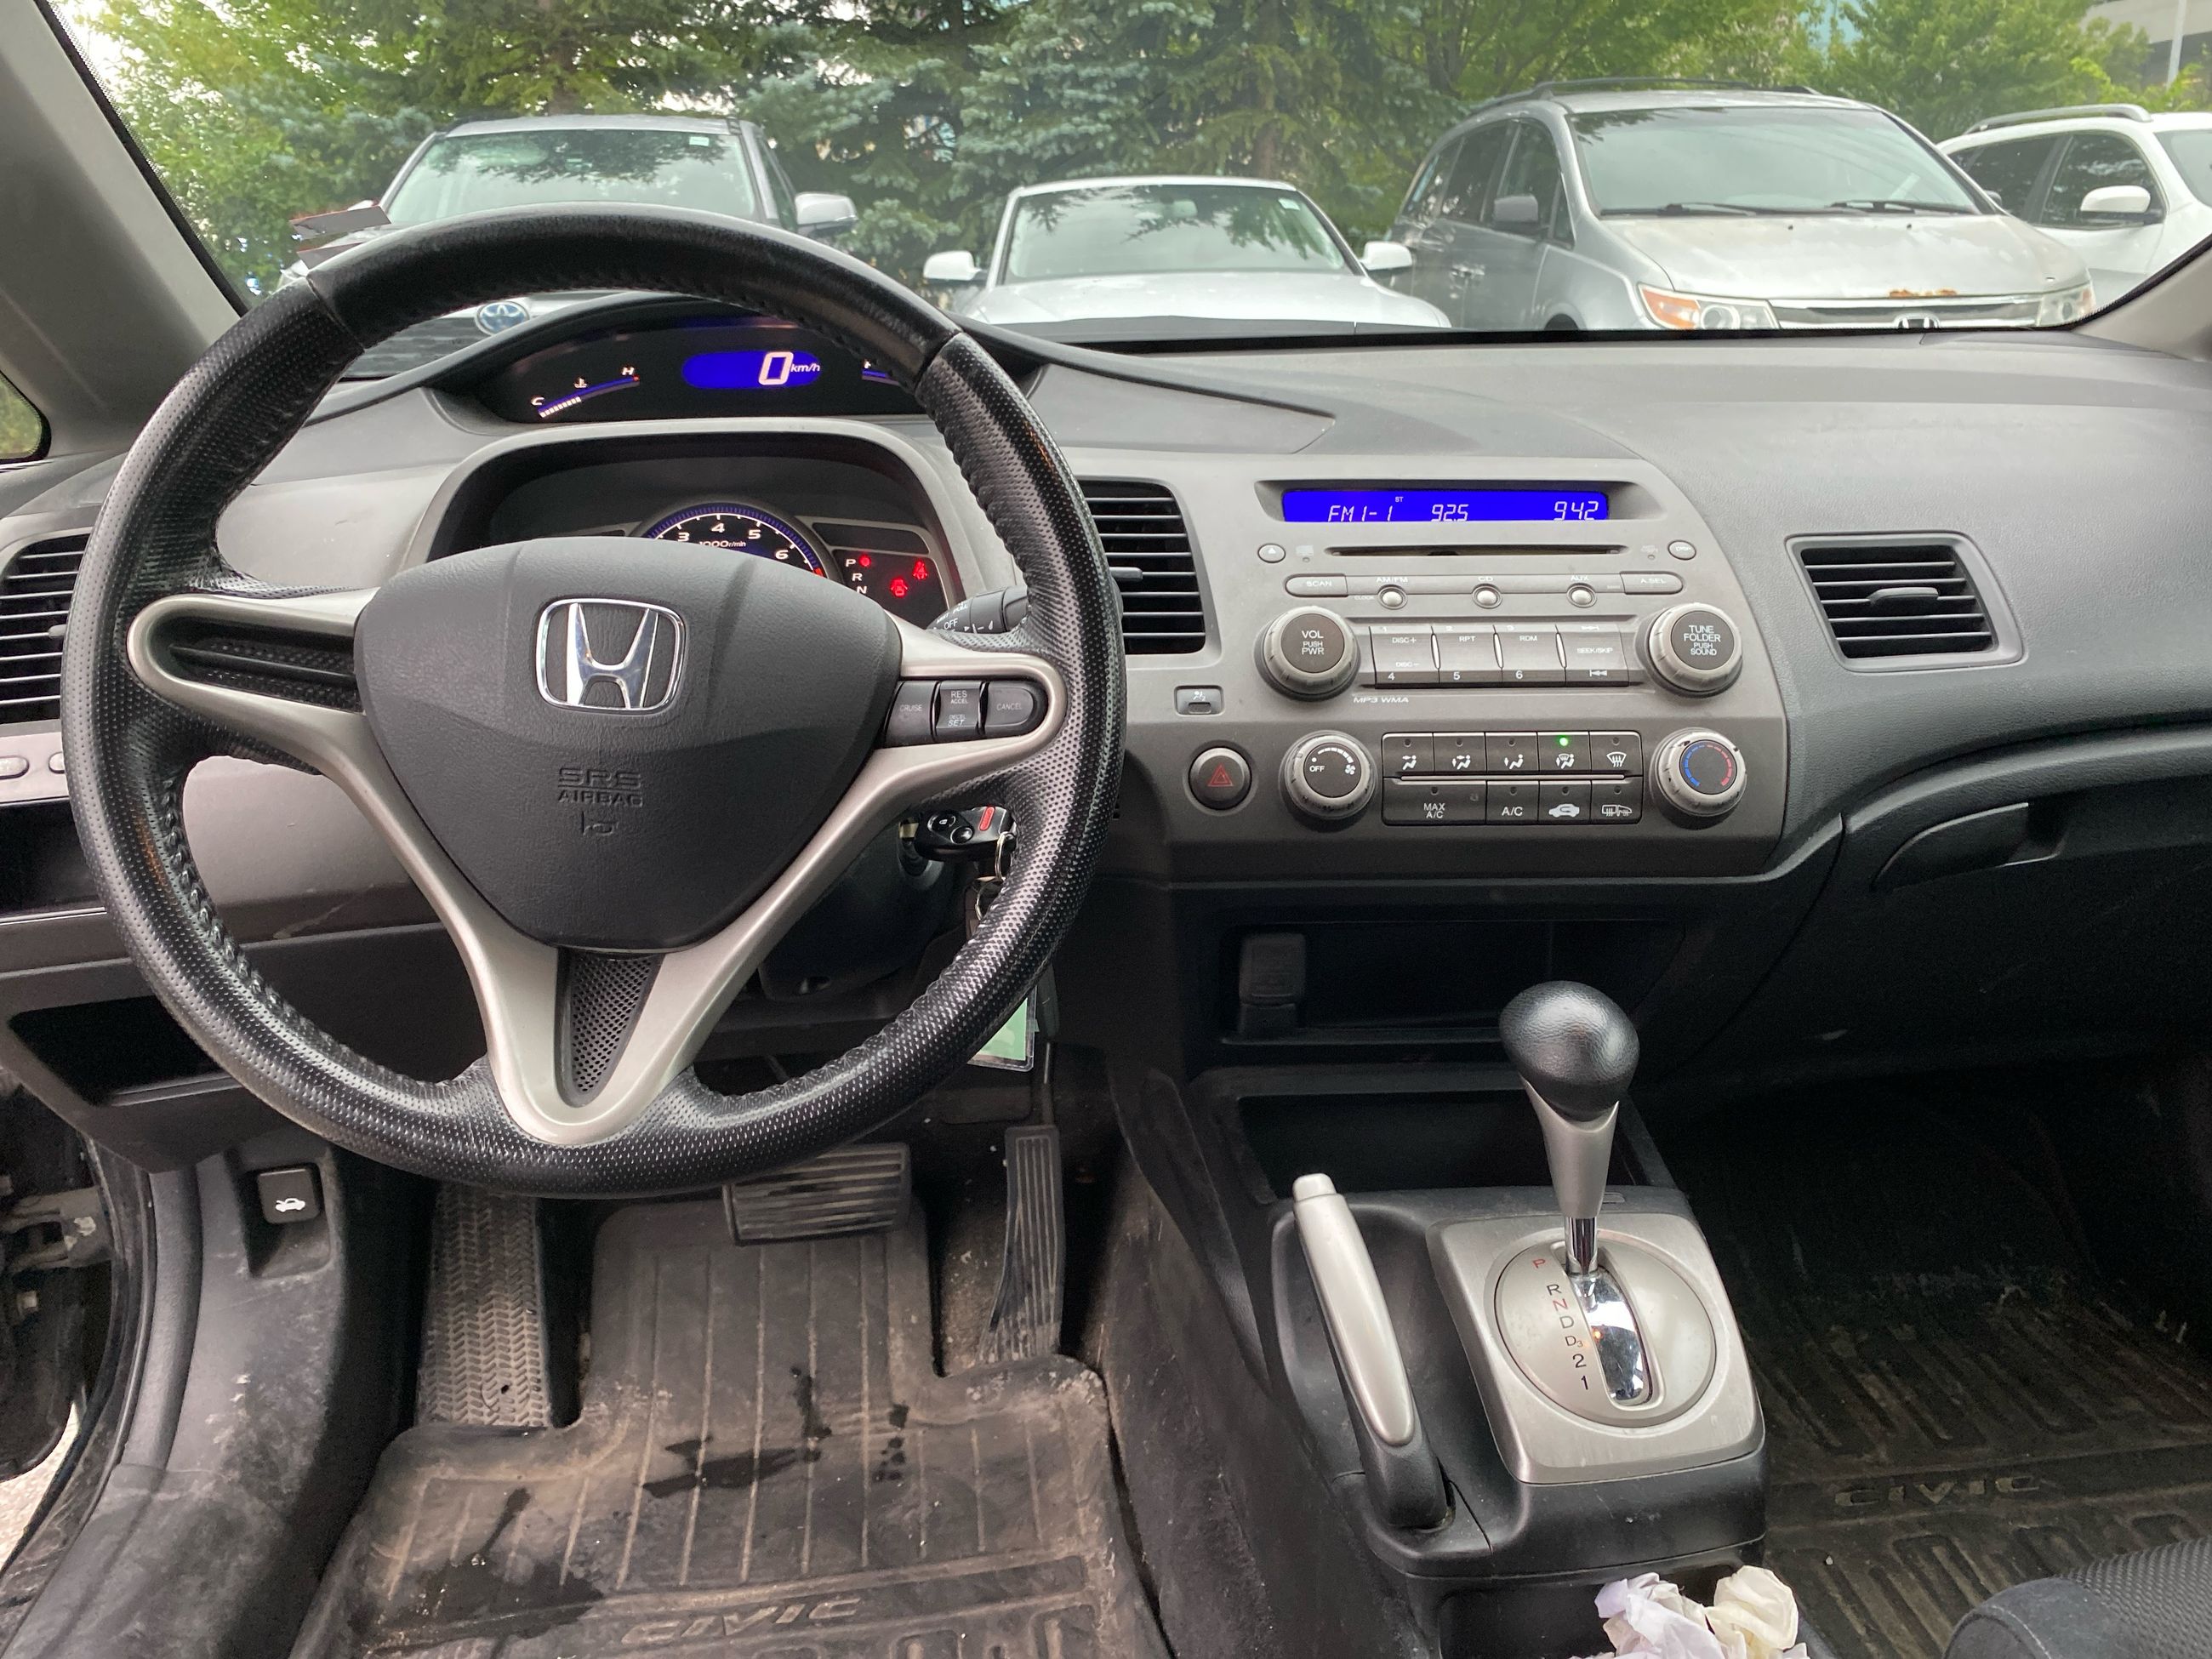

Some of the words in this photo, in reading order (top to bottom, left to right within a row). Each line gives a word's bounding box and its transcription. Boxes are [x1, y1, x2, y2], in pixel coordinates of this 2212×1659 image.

[622, 367, 635, 375] H
[759, 351, 794, 385] 0
[790, 362, 820, 373] km/h
[531, 396, 544, 406] C
[711, 523, 725, 533] 4
[677, 532, 690, 542] 3
[748, 529, 761, 539] 5
[775, 550, 789, 560] 6
[845, 558, 857, 567] P
[852, 573, 863, 581] R
[856, 585, 867, 594] N
[944, 618, 958, 630] OFF
[1689, 624, 1714, 634] TUNE
[1301, 630, 1324, 639] VOL
[1683, 633, 1721, 642] FOLDER
[1301, 647, 1325, 655] PWR
[1388, 672, 1395, 681] 4
[1452, 671, 1461, 681] 5
[1514, 670, 1523, 680] 6
[899, 704, 923, 712] CRUISE
[996, 702, 1023, 711] CANCEL
[558, 767, 642, 790] SRS
[557, 790, 644, 808] AIRBAG
[1426, 811, 1445, 819] A/C
[1501, 806, 1523, 817] A/C
[1532, 1258, 1546, 1269] P
[1547, 1284, 1561, 1296] R
[1553, 1298, 1567, 1311] N
[1559, 1315, 1574, 1329] D
[1572, 1354, 1587, 1368] 2
[1581, 1375, 1589, 1391] 1
[1834, 1475, 2041, 1508] CIVIC
[621, 1597, 862, 1646] CIVIC
